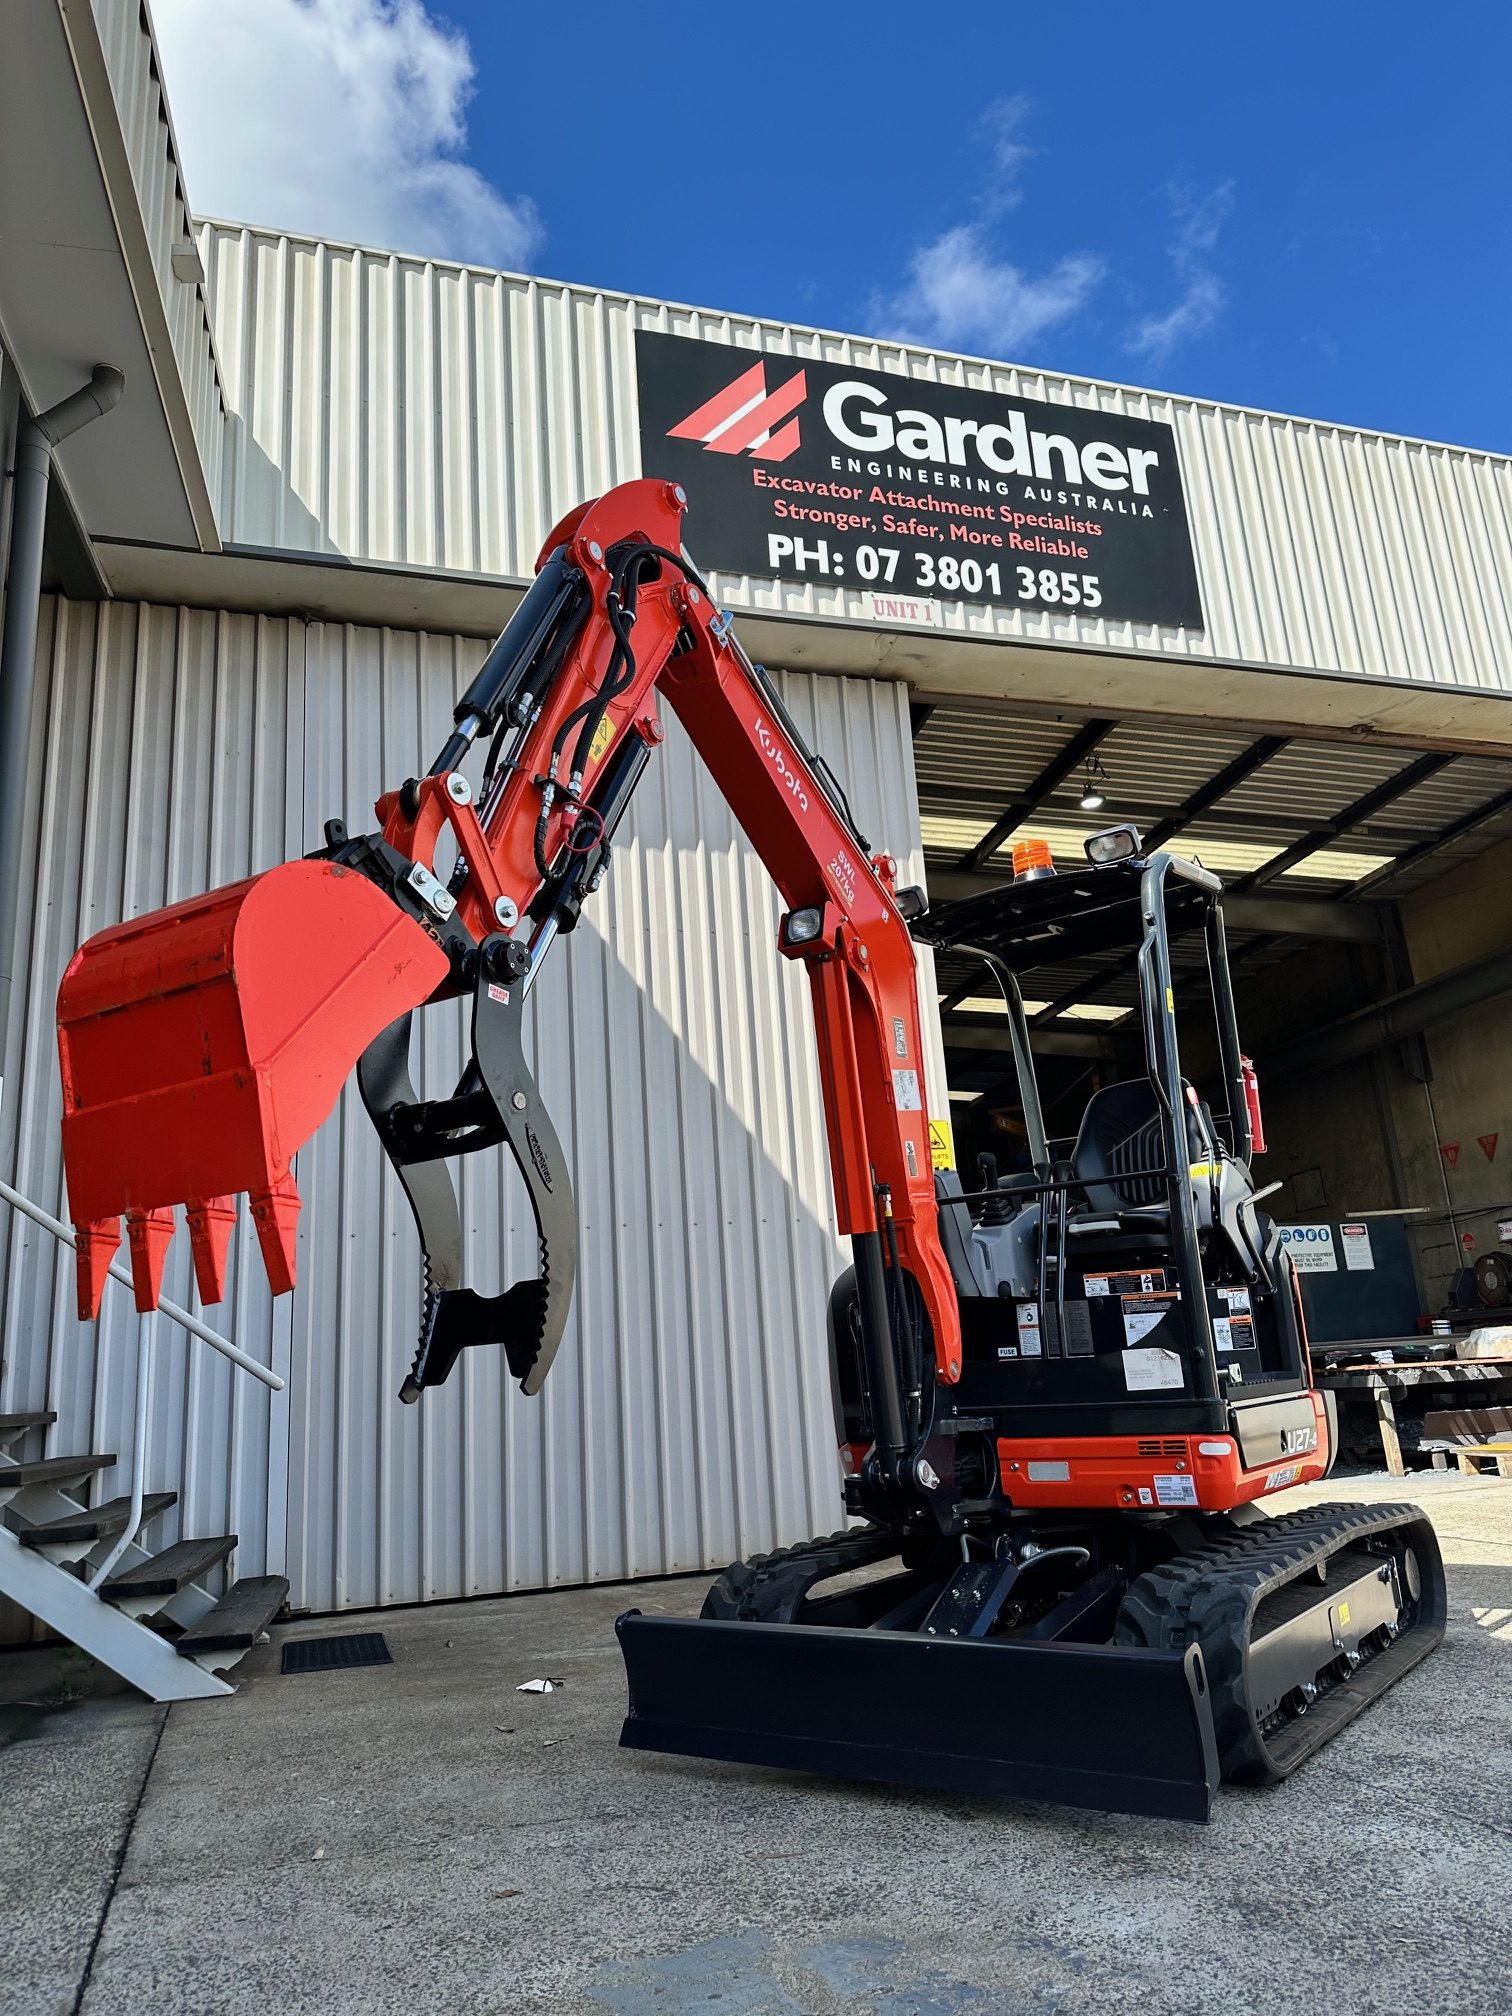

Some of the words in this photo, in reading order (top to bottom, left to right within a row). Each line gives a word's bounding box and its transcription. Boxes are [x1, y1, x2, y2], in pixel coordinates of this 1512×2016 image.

[822, 381, 1159, 496] Gardner
[753, 468, 863, 500] Excavator
[868, 486, 995, 521] Attachment
[1000, 505, 1102, 536] Specialists
[831, 455, 1010, 496] ENGINEERING
[1024, 486, 1153, 518] AUSTRALIA
[773, 499, 877, 533] Stronger,
[882, 514, 945, 542] Safer,
[950, 524, 1003, 547] More
[1008, 532, 1089, 559] Reliable
[767, 533, 845, 576] PH:
[856, 544, 900, 583] 07
[914, 552, 1002, 596] 3801
[1016, 566, 1103, 608] 3855
[873, 599, 918, 620] UNIT
[924, 604, 933, 621] 1
[754, 717, 808, 813] Kubota
[838, 850, 856, 885] SWL
[1287, 1428, 1317, 1453] U27-4
